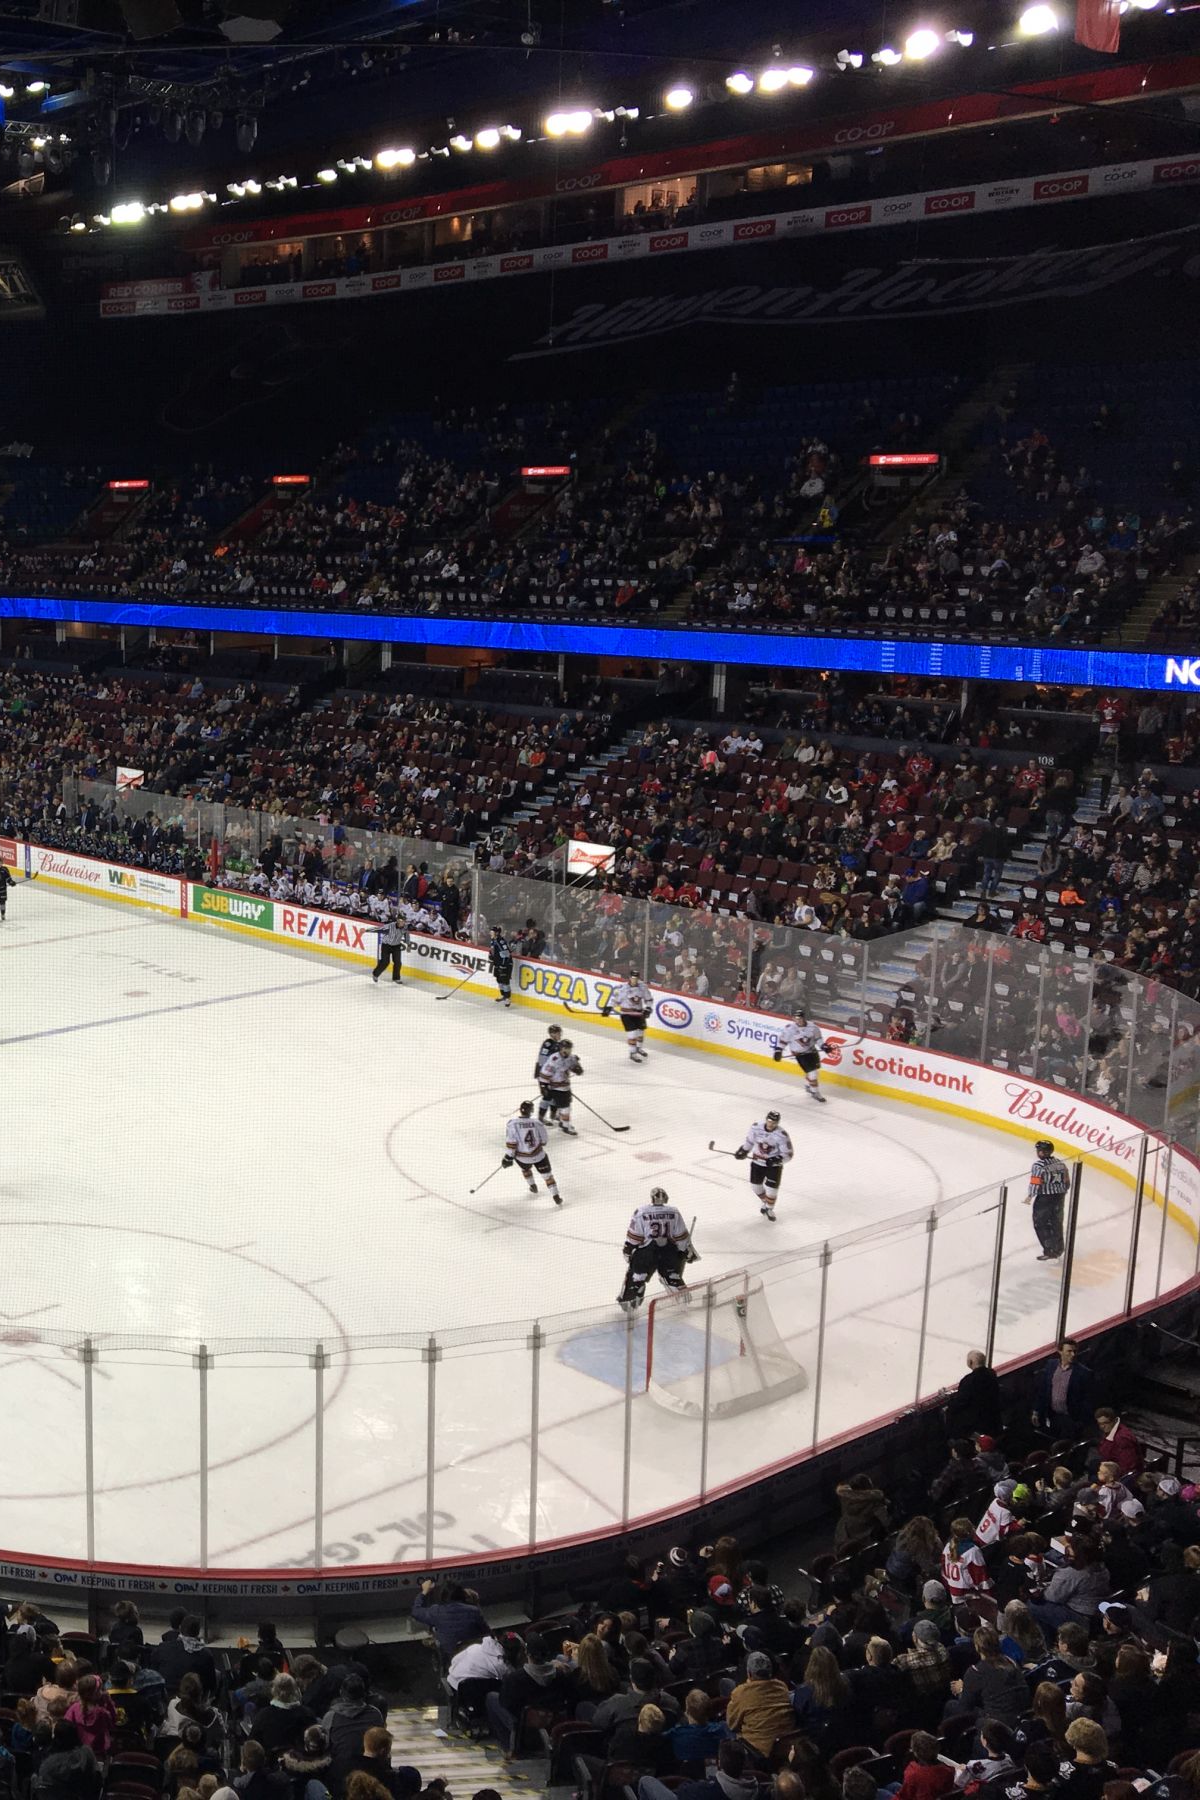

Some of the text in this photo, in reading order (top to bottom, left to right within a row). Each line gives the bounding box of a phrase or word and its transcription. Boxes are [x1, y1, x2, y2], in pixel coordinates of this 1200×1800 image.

[834, 121, 895, 143] CO-OP
[1039, 180, 1083, 195] CO-OP
[930, 196, 969, 210] CO-OP
[830, 210, 866, 223] CO-OP
[738, 223, 772, 236] CO-OP
[654, 236, 684, 248] CO-OP
[576, 248, 604, 259] CO-OP
[503, 258, 530, 269] CO-OP
[437, 268, 462, 278] CO-OP
[109, 282, 183, 298] RED CORNER
[305, 286, 334, 296] CO-OP
[1038, 756, 1055, 767] 108
[38, 852, 101, 882] Budweiser
[108, 869, 137, 888] WM
[201, 892, 265, 921] SUBWAY
[283, 909, 365, 950] RE/MAX
[519, 964, 588, 1005] PIZZA
[661, 1004, 688, 1022] Esso
[727, 1019, 779, 1048] Synerg
[852, 1049, 974, 1095] Scotiabank
[1004, 1082, 1136, 1160] Budweiser
[524, 1129, 535, 1148] 4
[649, 1221, 670, 1238] 31
[0, 1565, 8, 1576] IT
[10, 1566, 36, 1579] FRESH
[54, 1572, 155, 1590] OPA! KEEPING IT FRESH
[174, 1582, 278, 1594] OPA! KEEPING IT FRESH
[297, 1579, 398, 1594] OPA! KEEPING IT FRESH
